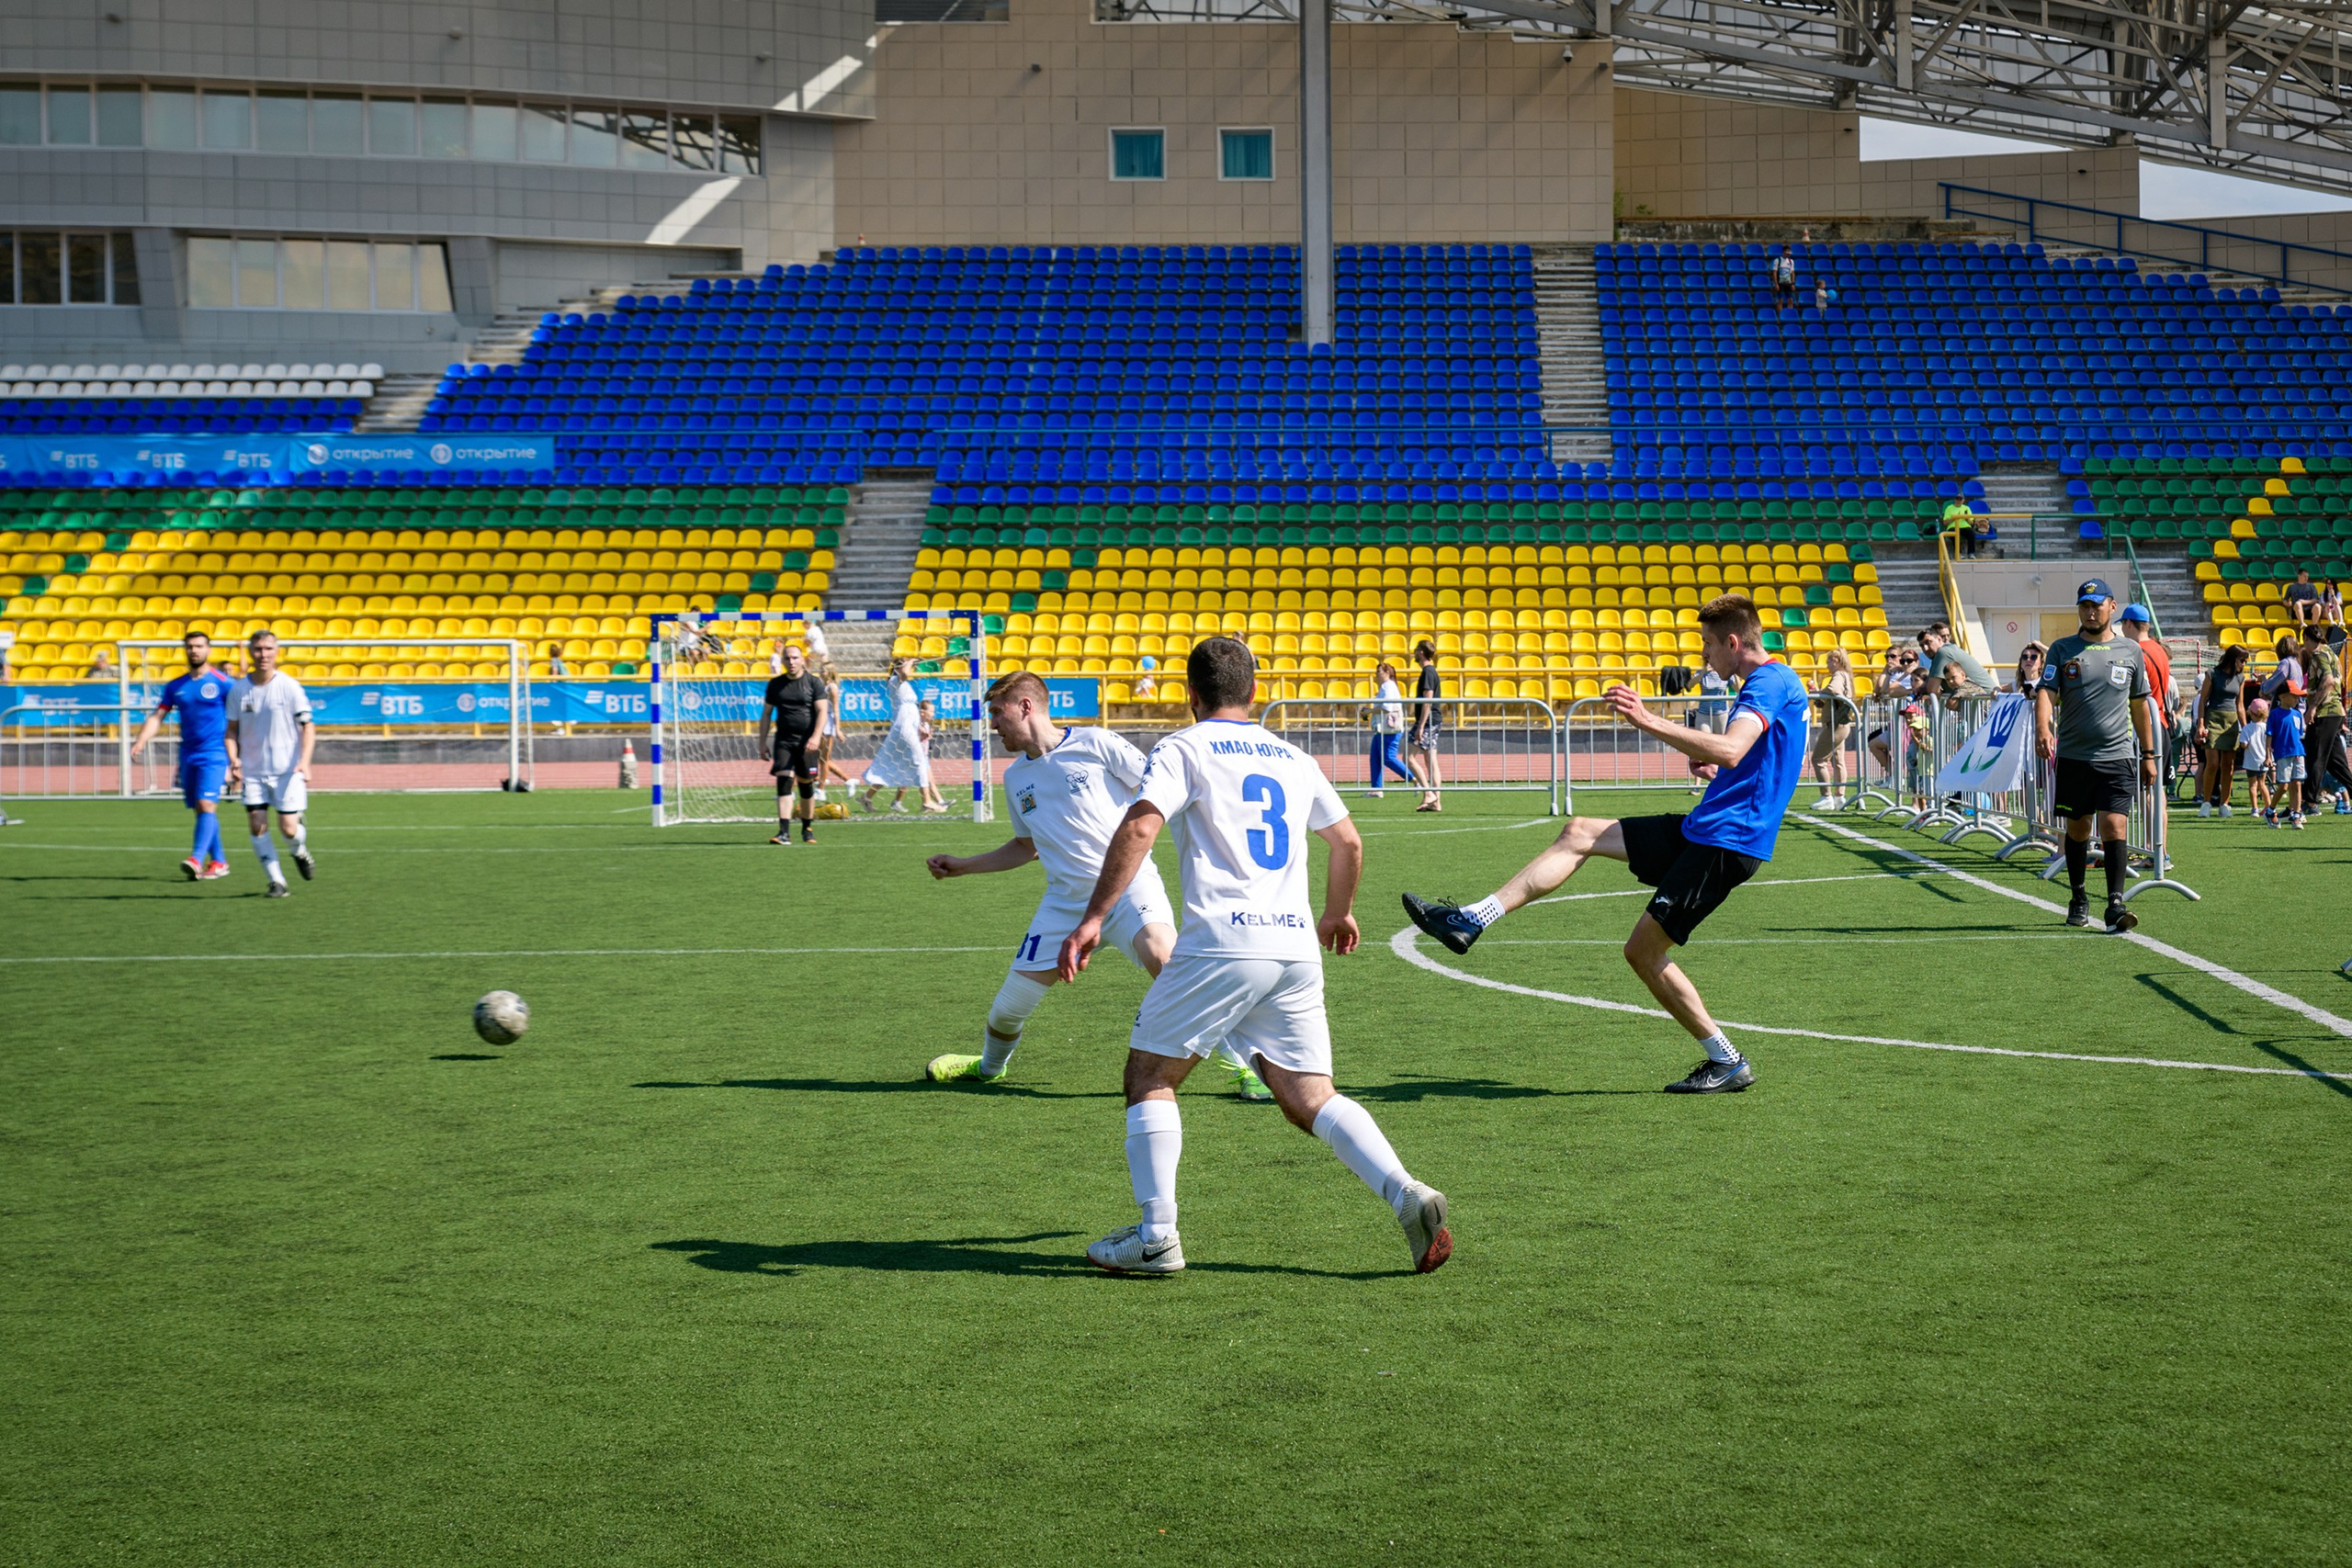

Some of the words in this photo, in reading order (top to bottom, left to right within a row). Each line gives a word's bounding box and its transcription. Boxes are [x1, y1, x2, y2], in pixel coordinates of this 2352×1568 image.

[65, 454, 98, 468] ВТБ
[153, 453, 186, 468] ВТБ
[238, 453, 272, 468] ВТБ
[333, 447, 413, 461] открытие
[456, 447, 537, 461] открытие
[380, 695, 424, 716] ВТБ
[605, 694, 647, 713] ВТБ
[704, 695, 765, 708] открыти
[845, 692, 883, 711] ВТБ
[1049, 691, 1075, 707] ТБ
[1242, 773, 1289, 870] 3
[1231, 911, 1296, 928] KELME
